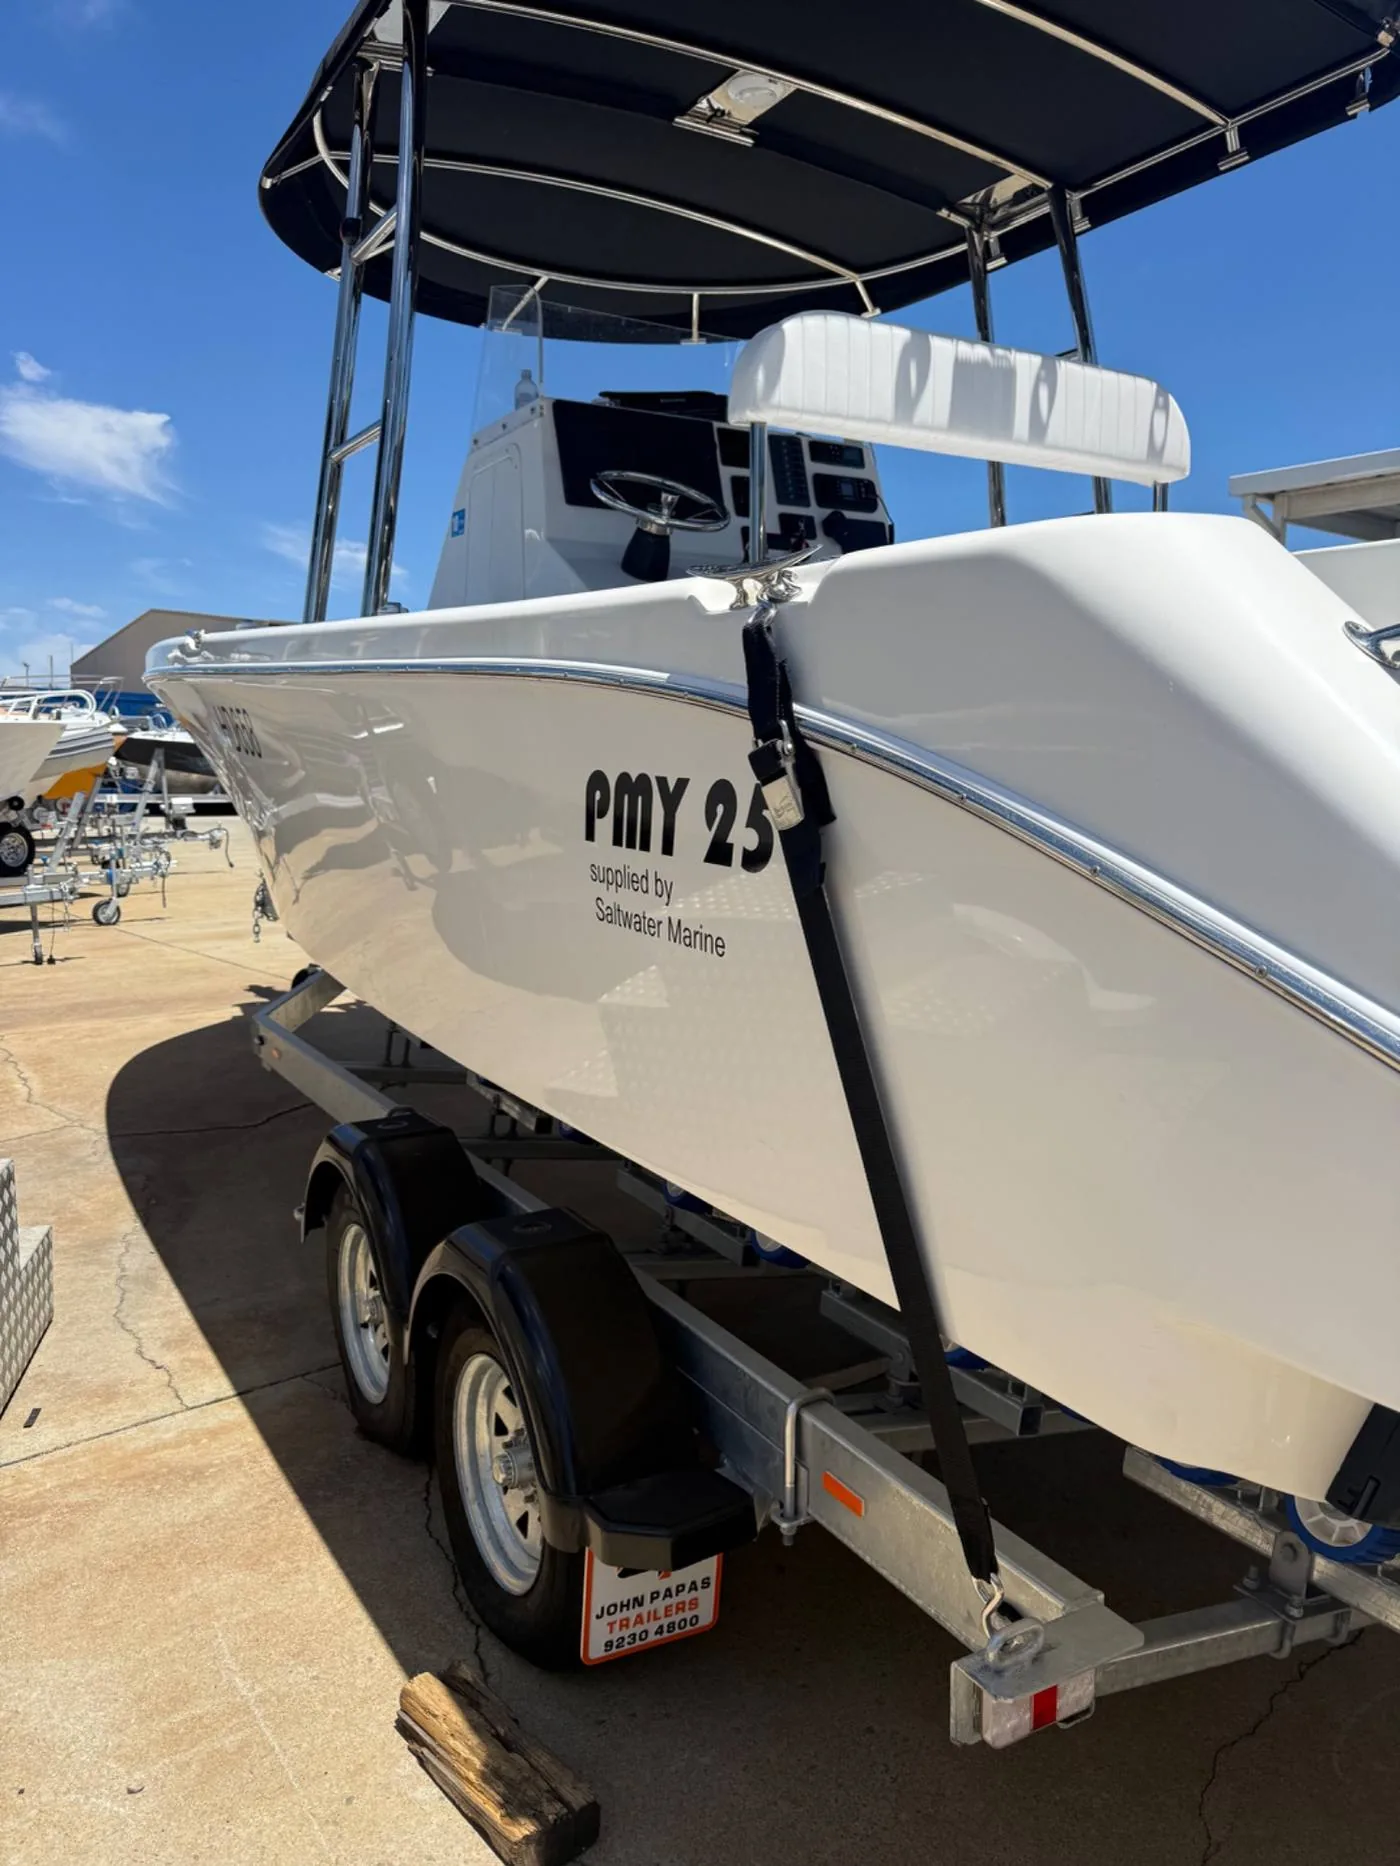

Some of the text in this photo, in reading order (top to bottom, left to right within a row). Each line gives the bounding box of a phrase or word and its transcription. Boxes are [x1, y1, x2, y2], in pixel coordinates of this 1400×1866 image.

[585, 769, 774, 873] PMY 25
[589, 863, 674, 907] supplied by
[595, 897, 726, 957] Saltwater Marine
[595, 1576, 711, 1620] JOHN PAPAS
[607, 1597, 699, 1635] TRAILERS
[604, 1614, 699, 1653] 9230 4800
